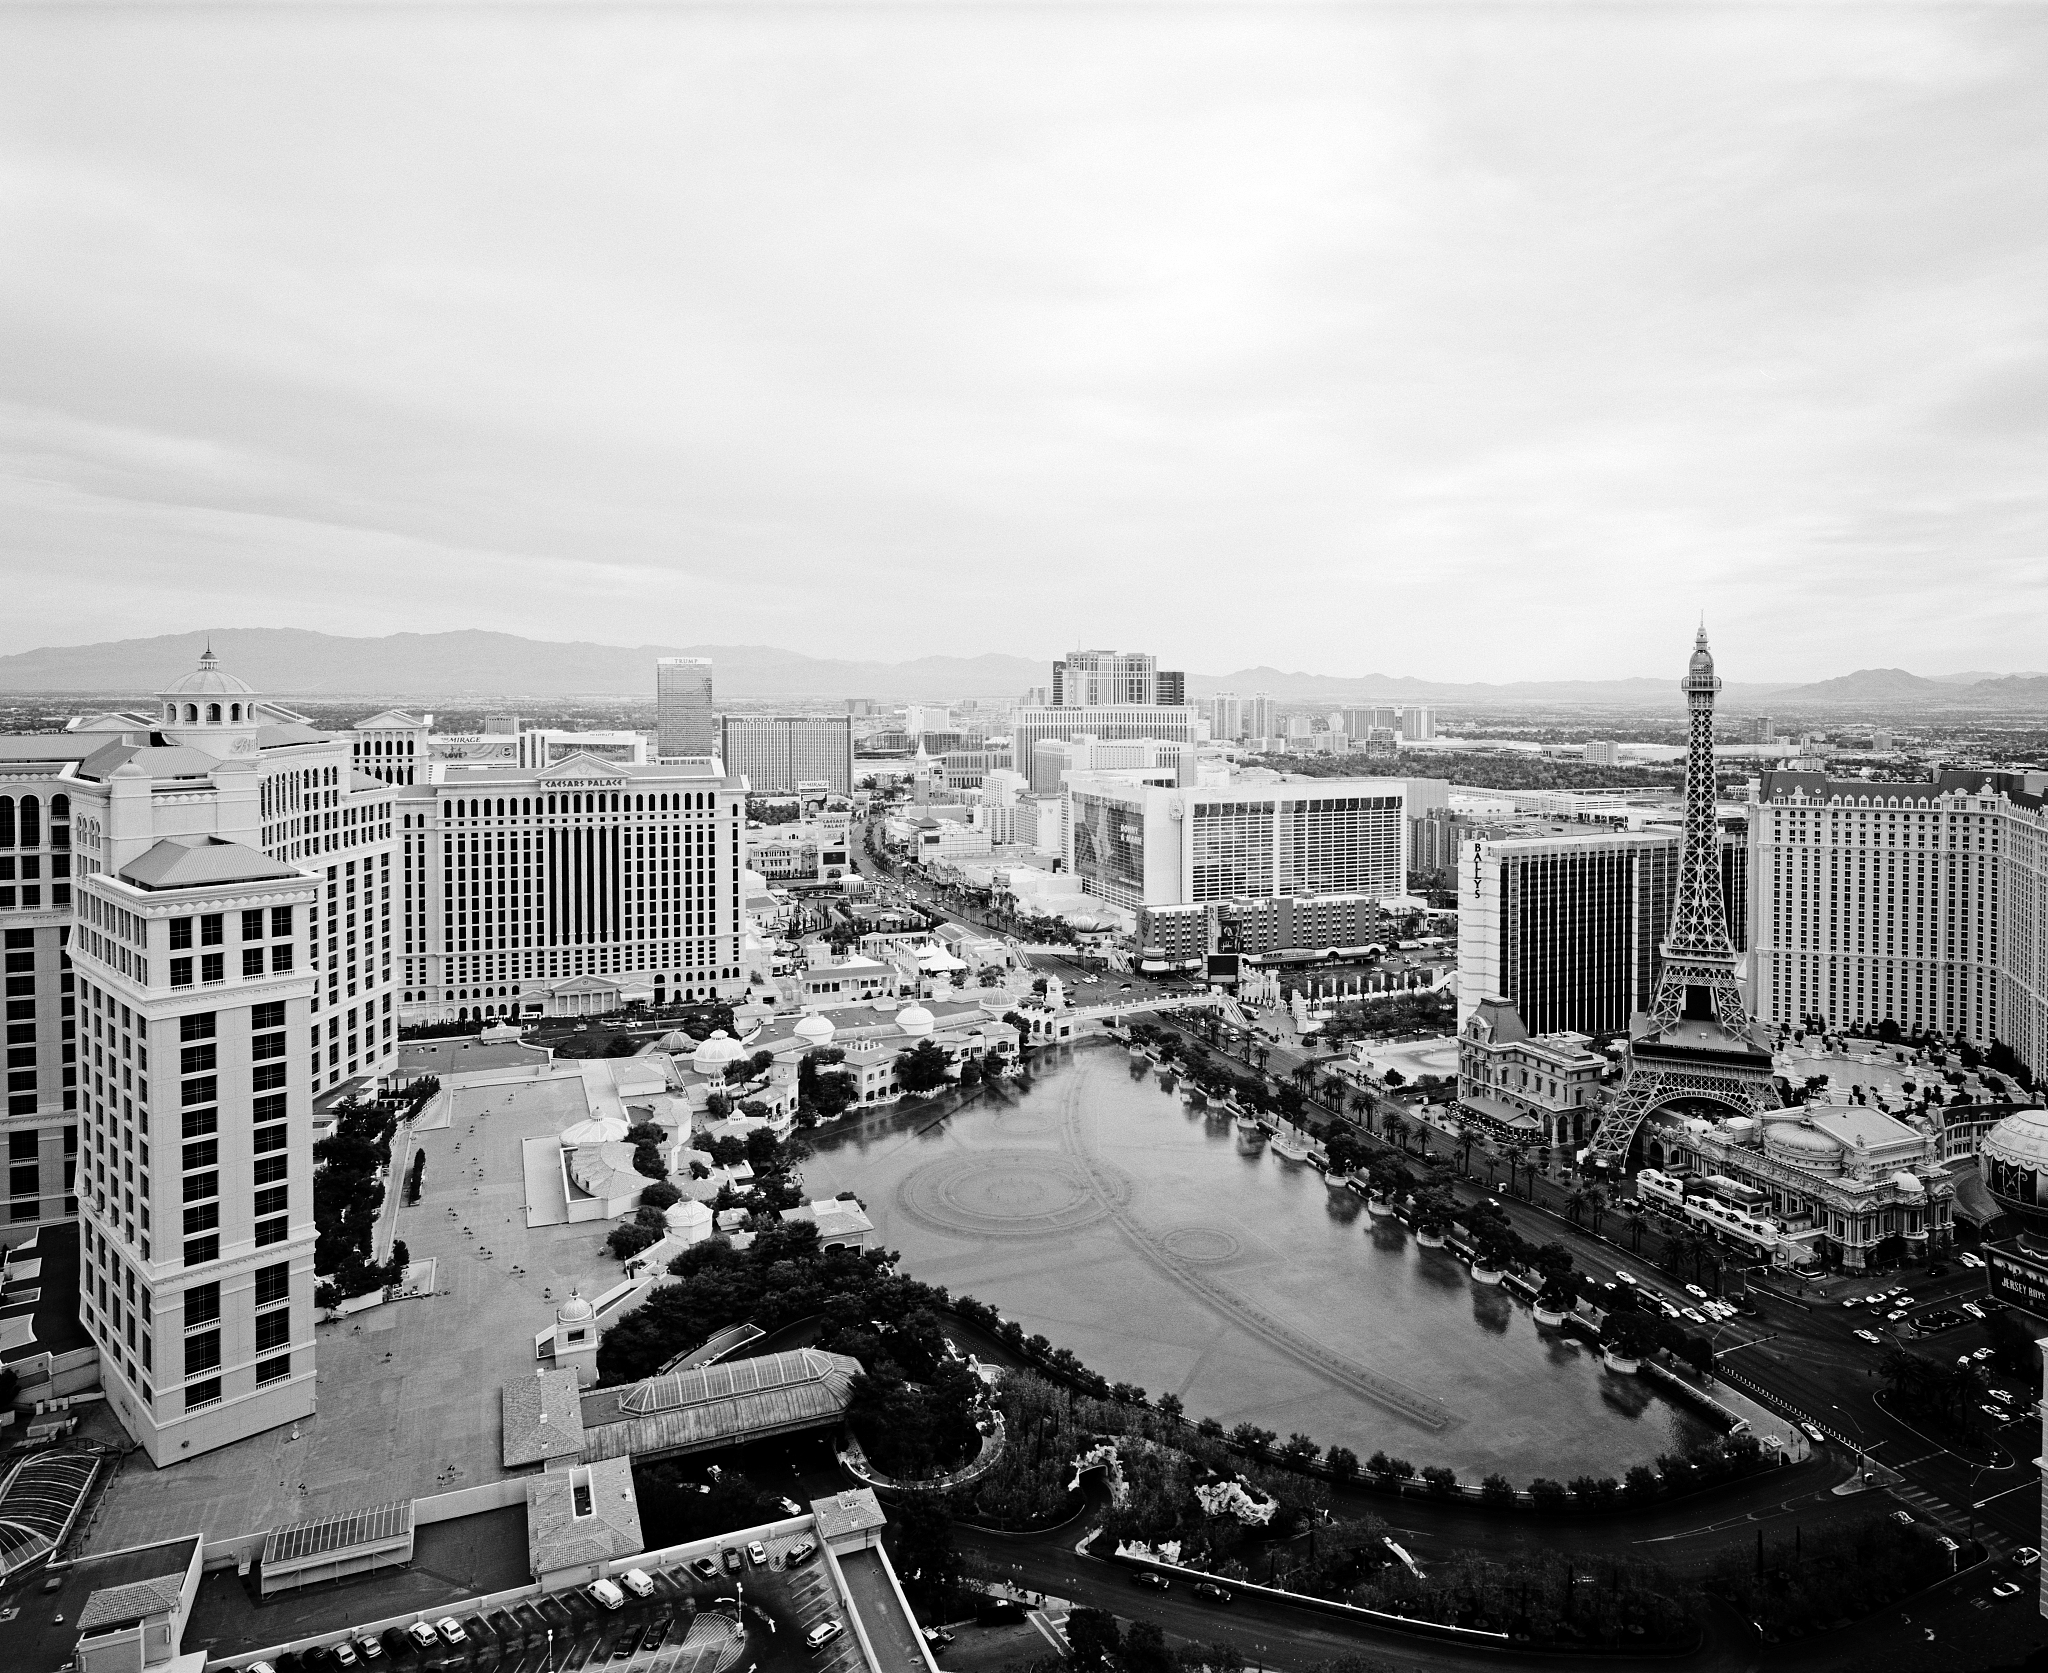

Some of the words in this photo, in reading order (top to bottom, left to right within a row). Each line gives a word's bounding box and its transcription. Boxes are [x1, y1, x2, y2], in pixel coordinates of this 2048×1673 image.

[545, 780, 585, 788] CAESARS
[587, 779, 623, 787] PALACE
[1473, 842, 1482, 899] BALLYS
[2001, 1277, 2027, 1295] JERSEY
[2028, 1286, 2046, 1301] BOYS
